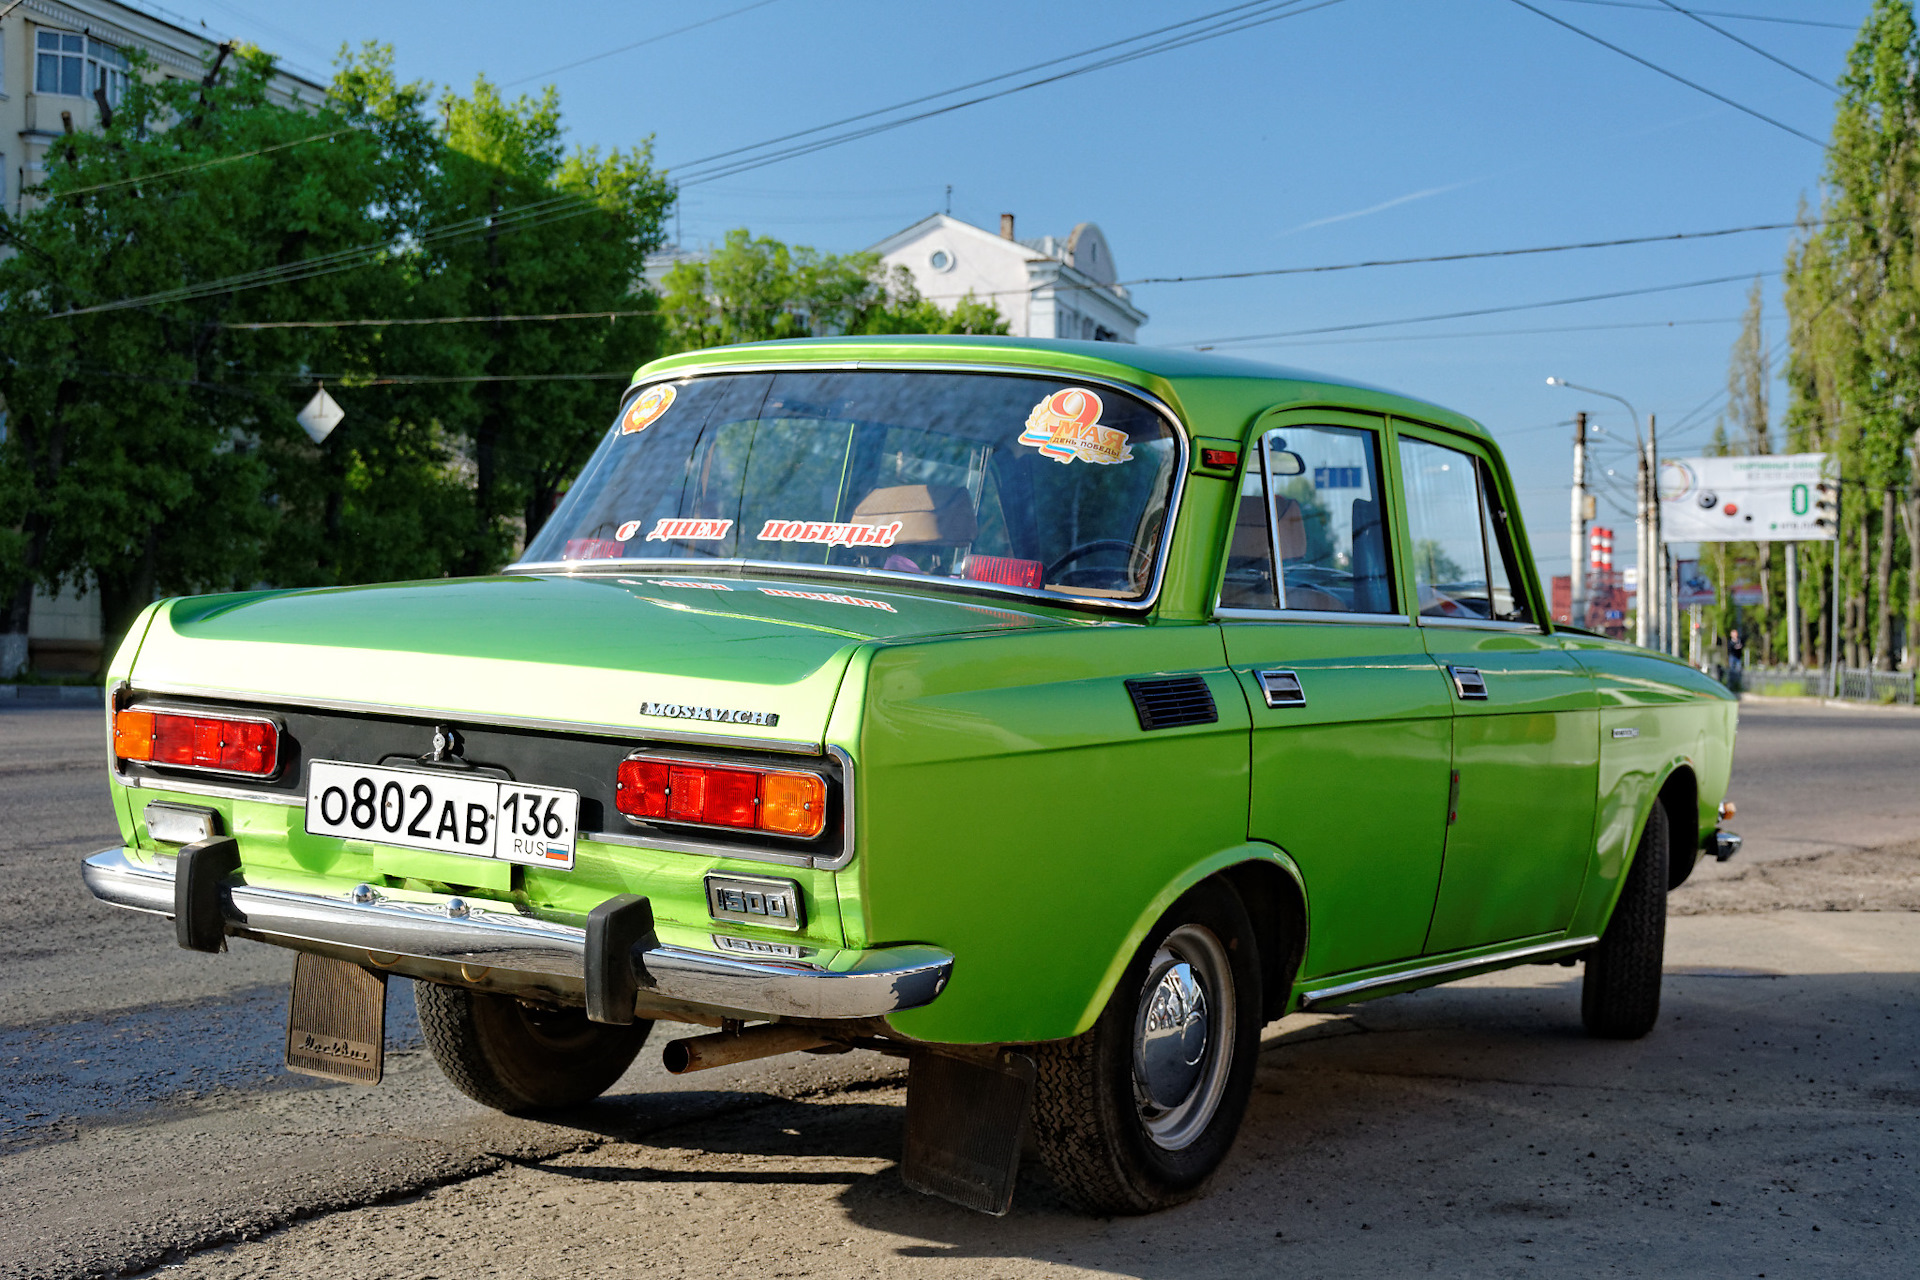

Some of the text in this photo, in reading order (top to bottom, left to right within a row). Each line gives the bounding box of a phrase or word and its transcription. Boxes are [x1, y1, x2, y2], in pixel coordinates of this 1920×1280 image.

[1048, 390, 1100, 434] 9
[1053, 437, 1120, 457] ДЕНЬ ПОБЕДЫ
[1055, 420, 1126, 451] МАЯ
[617, 519, 901, 547] С ДНЕМ ПОБЕДЫ!
[645, 701, 769, 726] MOSKVICH
[503, 792, 562, 840] 136
[514, 838, 544, 857] RUS
[715, 887, 788, 918] 1500
